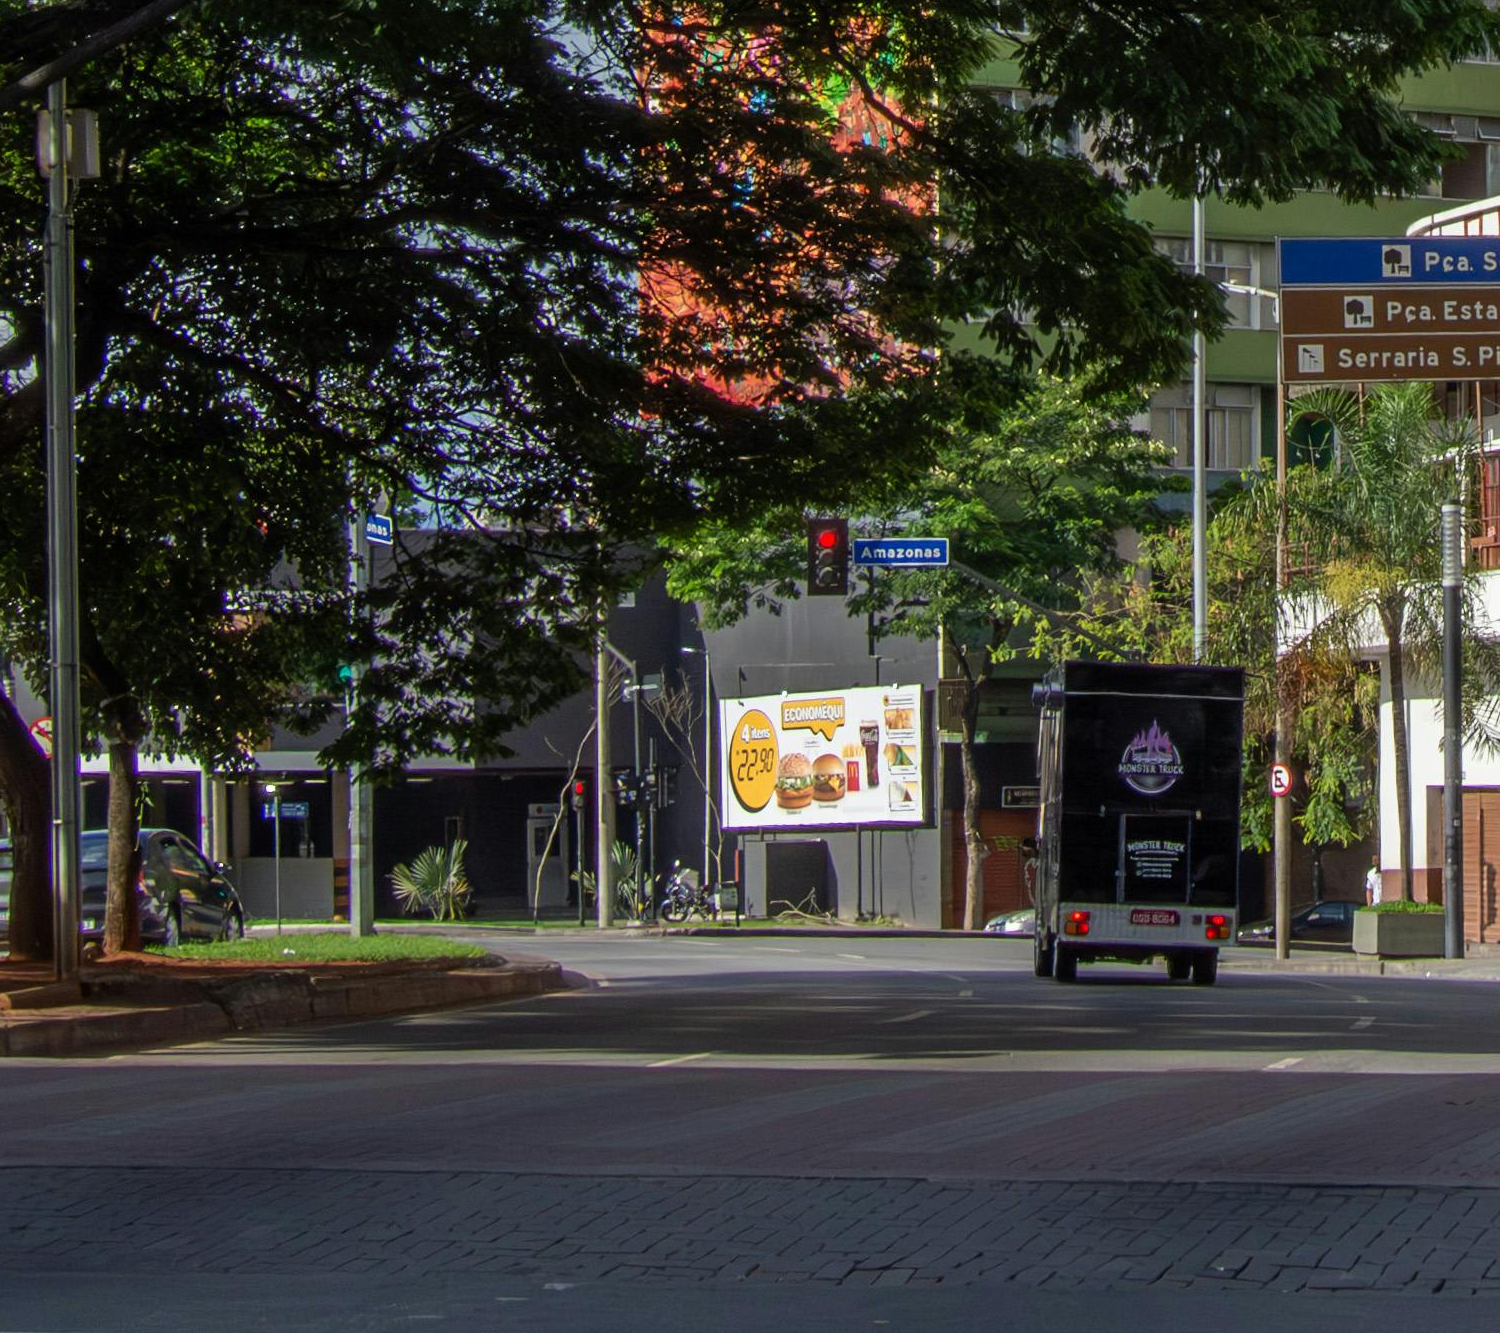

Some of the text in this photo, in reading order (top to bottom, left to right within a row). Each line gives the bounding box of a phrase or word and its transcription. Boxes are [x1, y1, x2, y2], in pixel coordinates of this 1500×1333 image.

[1425, 251, 1474, 273] Pça.
[1387, 300, 1436, 323] Pça.
[1338, 347, 1440, 369] Serraria
[1452, 347, 1471, 367] S.
[366, 523, 388, 536] onas
[861, 546, 941, 559] Amazonas
[783, 702, 845, 722] ECONOMÉQUI
[741, 724, 750, 743] 4
[737, 747, 775, 782] 22,90
[1118, 763, 1184, 775] MONSTER TRUCK
